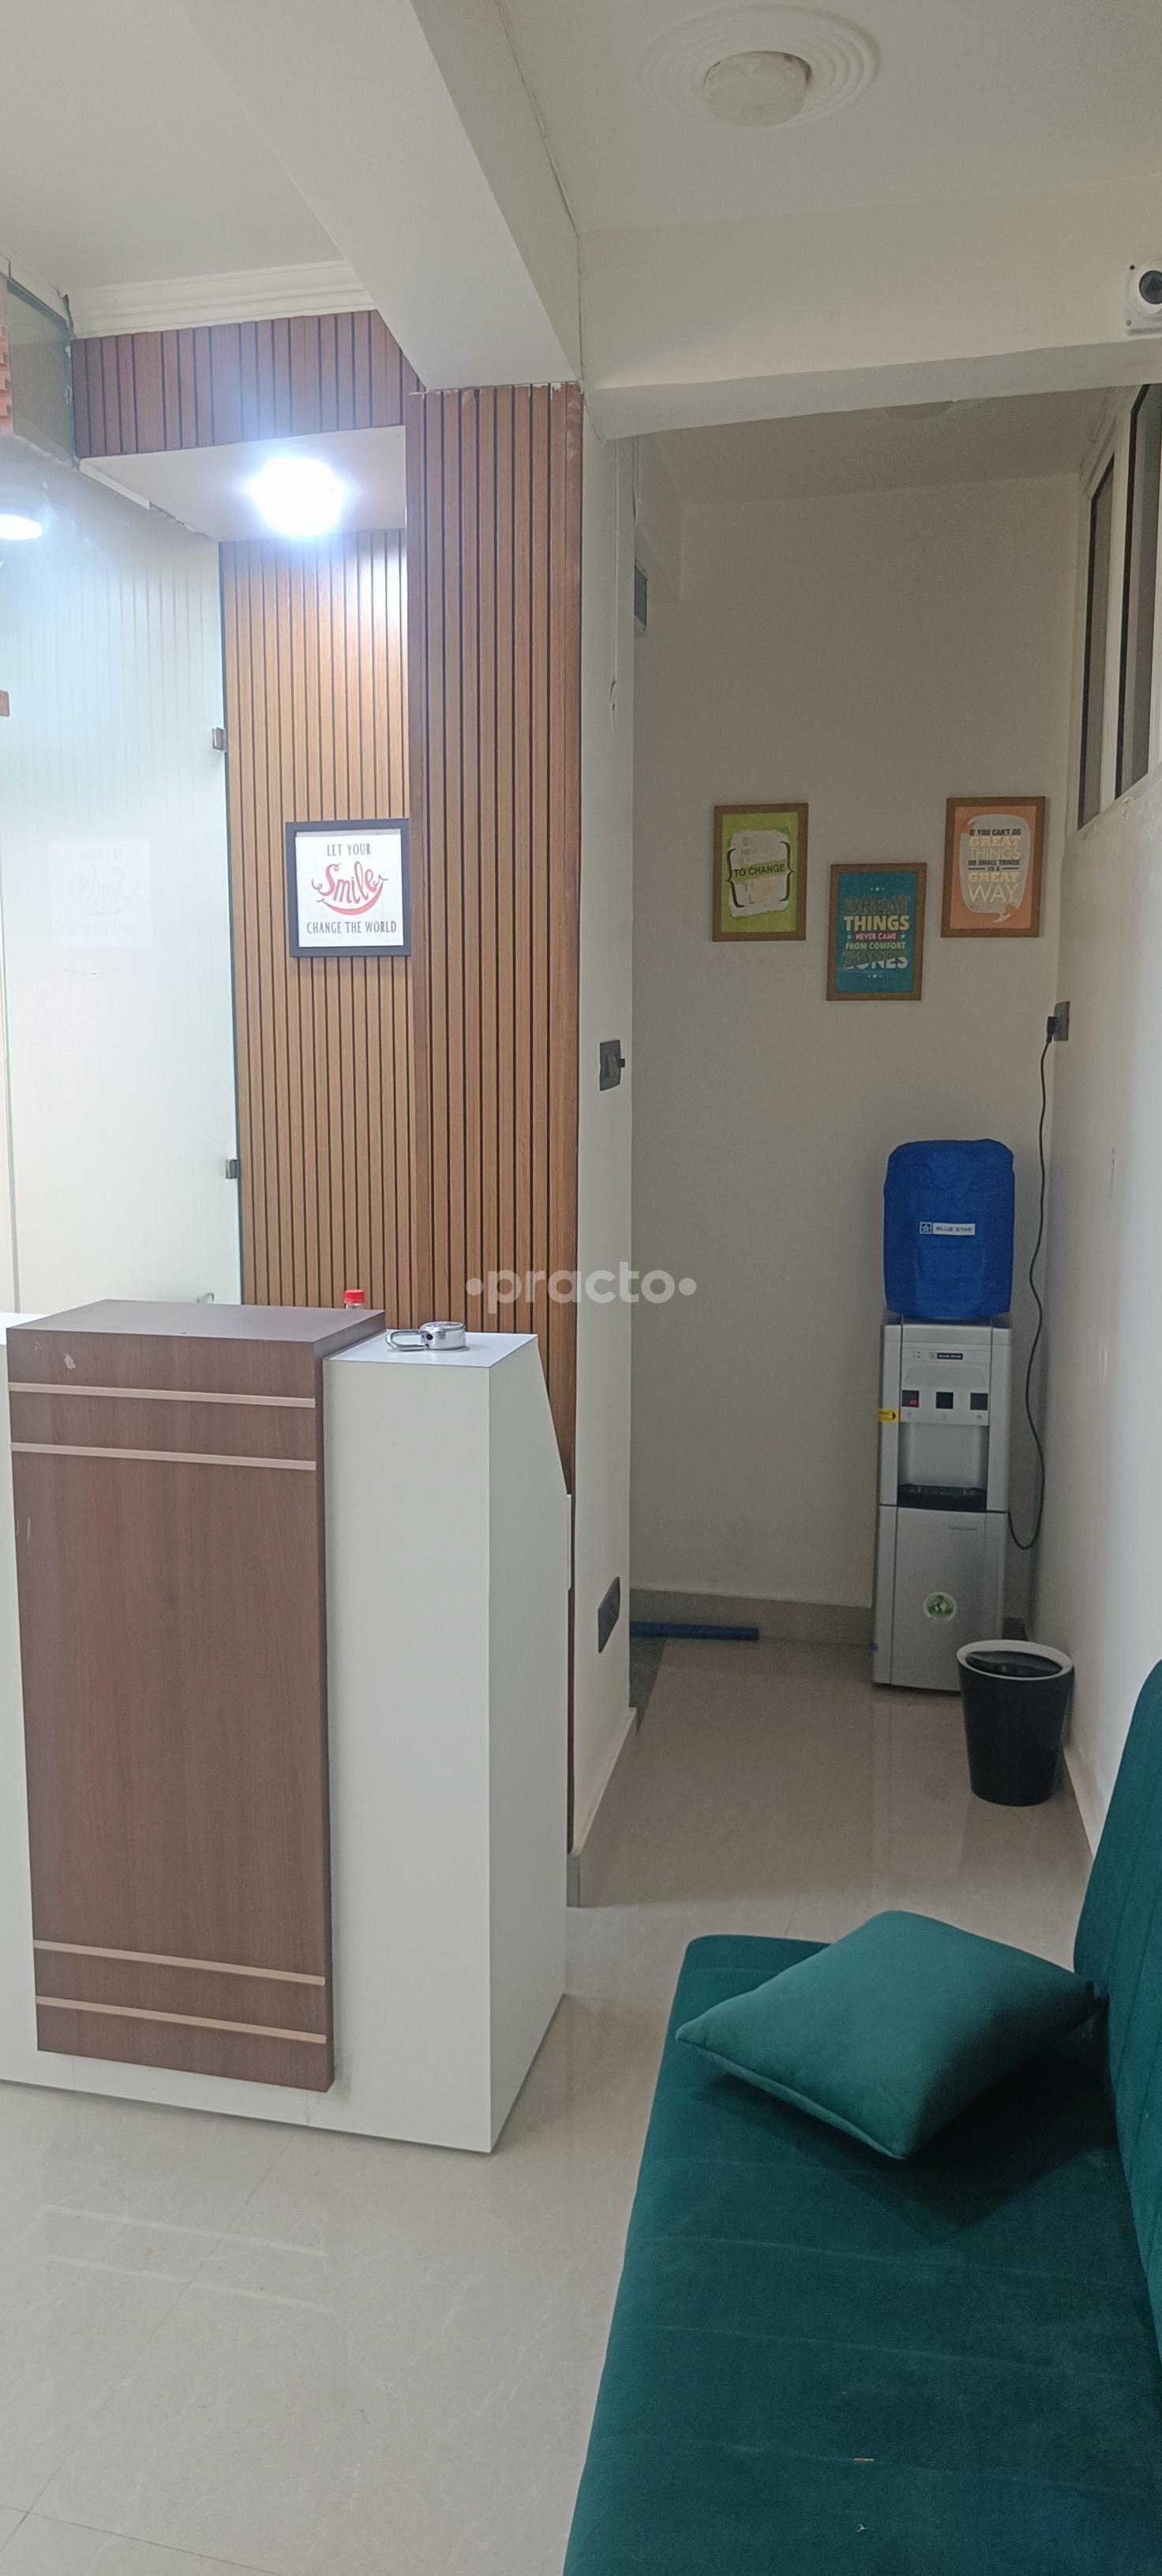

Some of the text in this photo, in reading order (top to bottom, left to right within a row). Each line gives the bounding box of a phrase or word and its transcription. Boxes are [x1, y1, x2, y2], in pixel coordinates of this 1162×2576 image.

[969, 836, 1021, 847] GREAT
[327, 843, 371, 856] LET YOUR
[733, 863, 785, 878] TO CHANGE
[968, 872, 1019, 883] GREAT
[311, 861, 388, 904] Smile
[845, 896, 910, 915] GREAT
[306, 920, 397, 934] CHANGE THE WORLD
[843, 915, 909, 932] THINGS
[843, 951, 909, 970] ZONES
